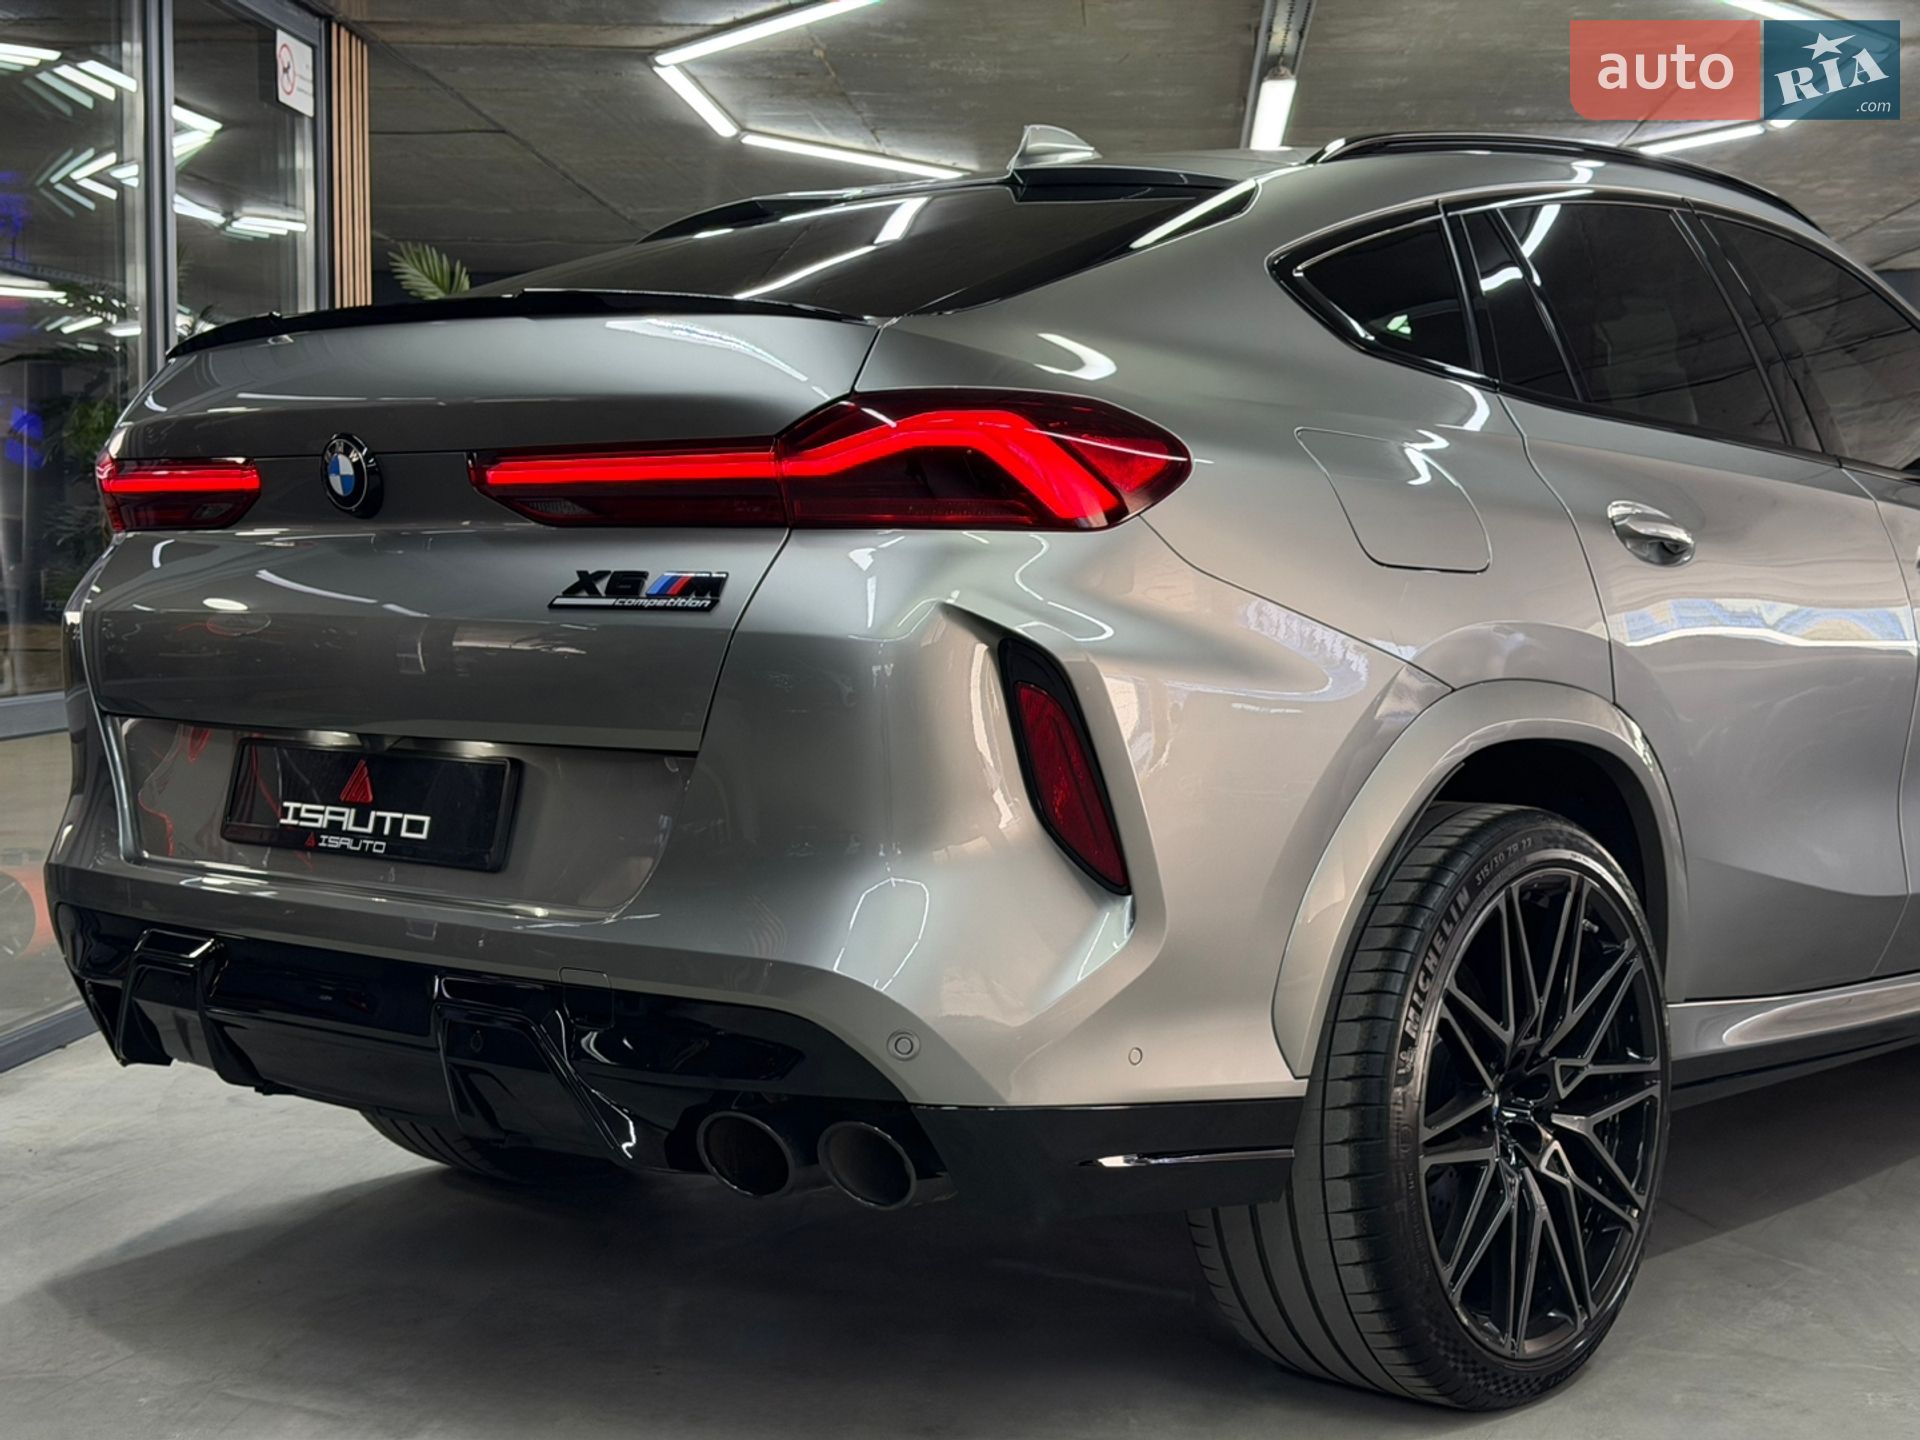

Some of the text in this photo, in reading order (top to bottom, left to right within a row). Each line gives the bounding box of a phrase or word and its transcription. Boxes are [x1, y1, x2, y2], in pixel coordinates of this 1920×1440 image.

[614, 597, 711, 608] competition
[280, 802, 431, 839] ISAUTO
[318, 835, 386, 854] ISAUTO
[1405, 888, 1470, 1040] MICHELIN
